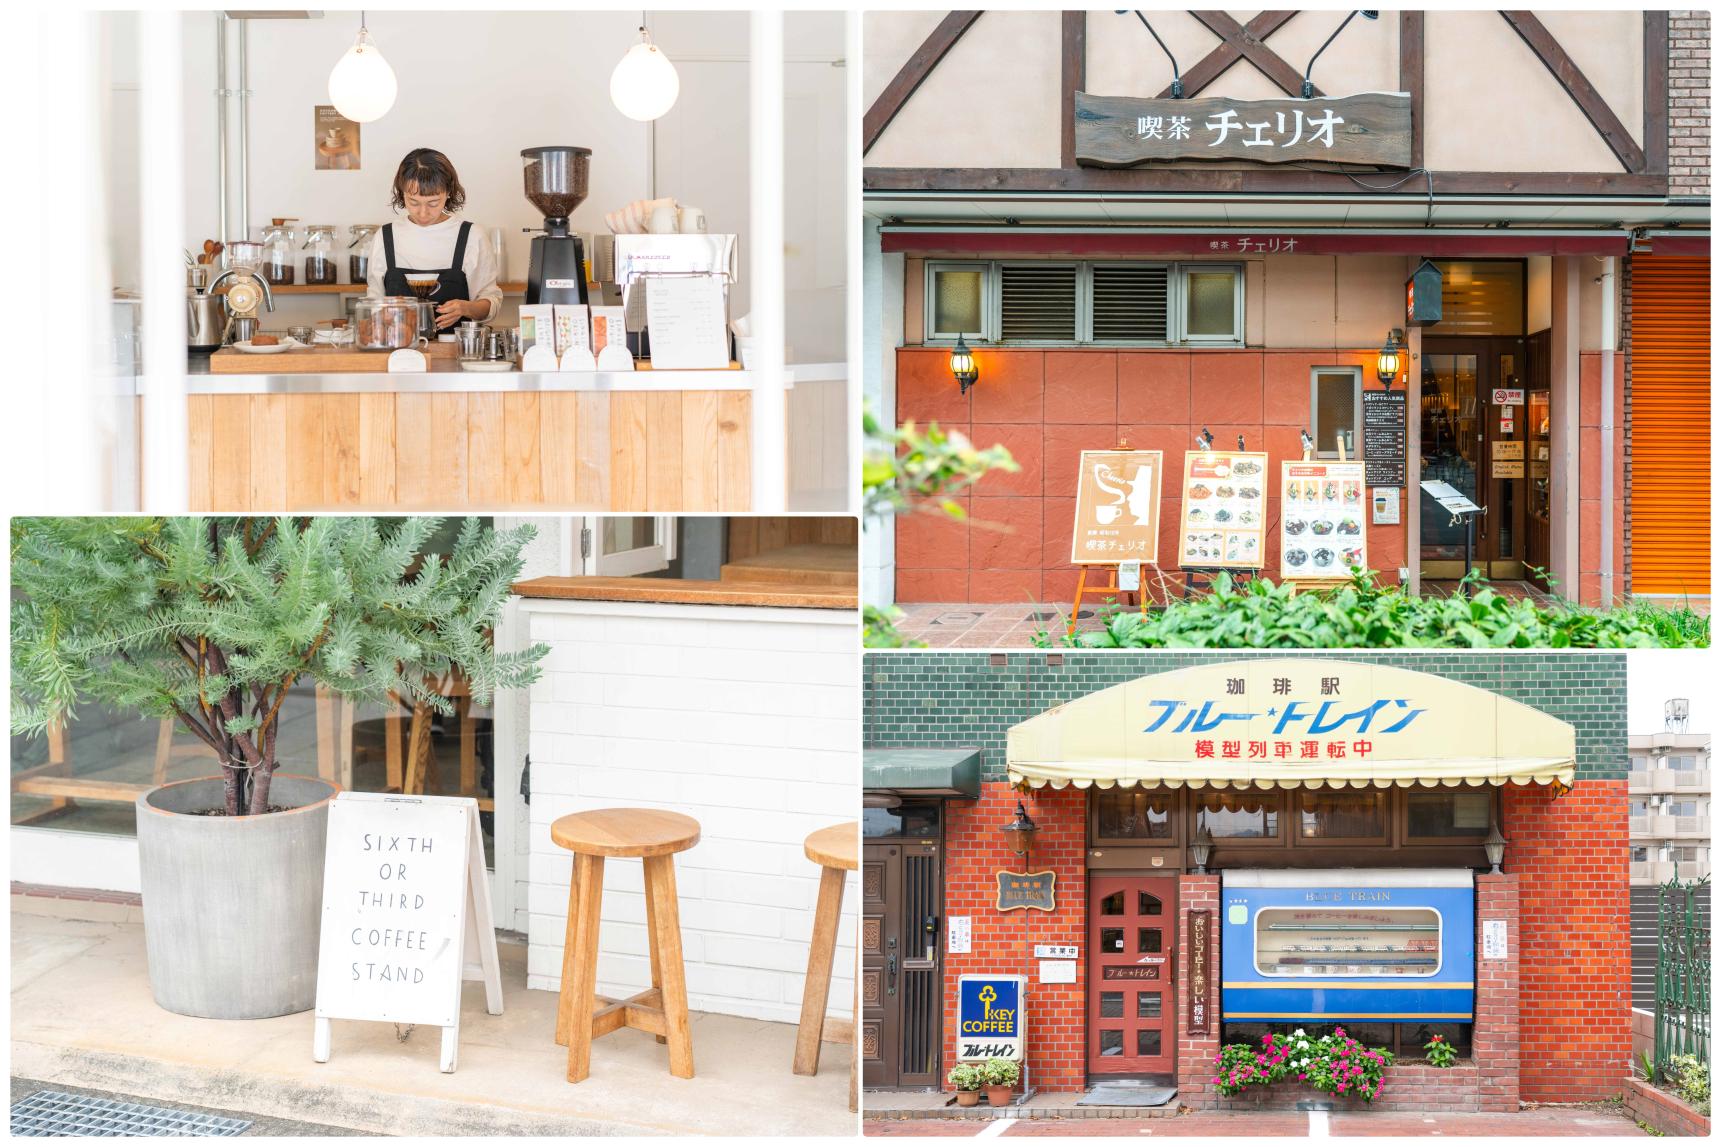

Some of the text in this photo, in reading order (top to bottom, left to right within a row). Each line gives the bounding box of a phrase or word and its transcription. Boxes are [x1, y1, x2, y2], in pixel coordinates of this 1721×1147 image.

[1137, 109, 1345, 148] 喫茶 チェリオ
[1209, 237, 1298, 253] 喫茶 チェリオ
[1086, 538, 1147, 553] 喫茶チェリオ
[1226, 677, 1340, 695] 珈琲駅
[1195, 739, 1373, 759] 模型列車運転中
[363, 833, 433, 853] SIXTH
[379, 863, 407, 880] OR
[359, 891, 424, 910] THIRD
[1350, 891, 1391, 901] TRAIN
[351, 928, 427, 950] COFFEE
[352, 962, 424, 984] STAND
[989, 1009, 1016, 1020] KEY
[963, 1021, 1014, 1033] COFFEE
